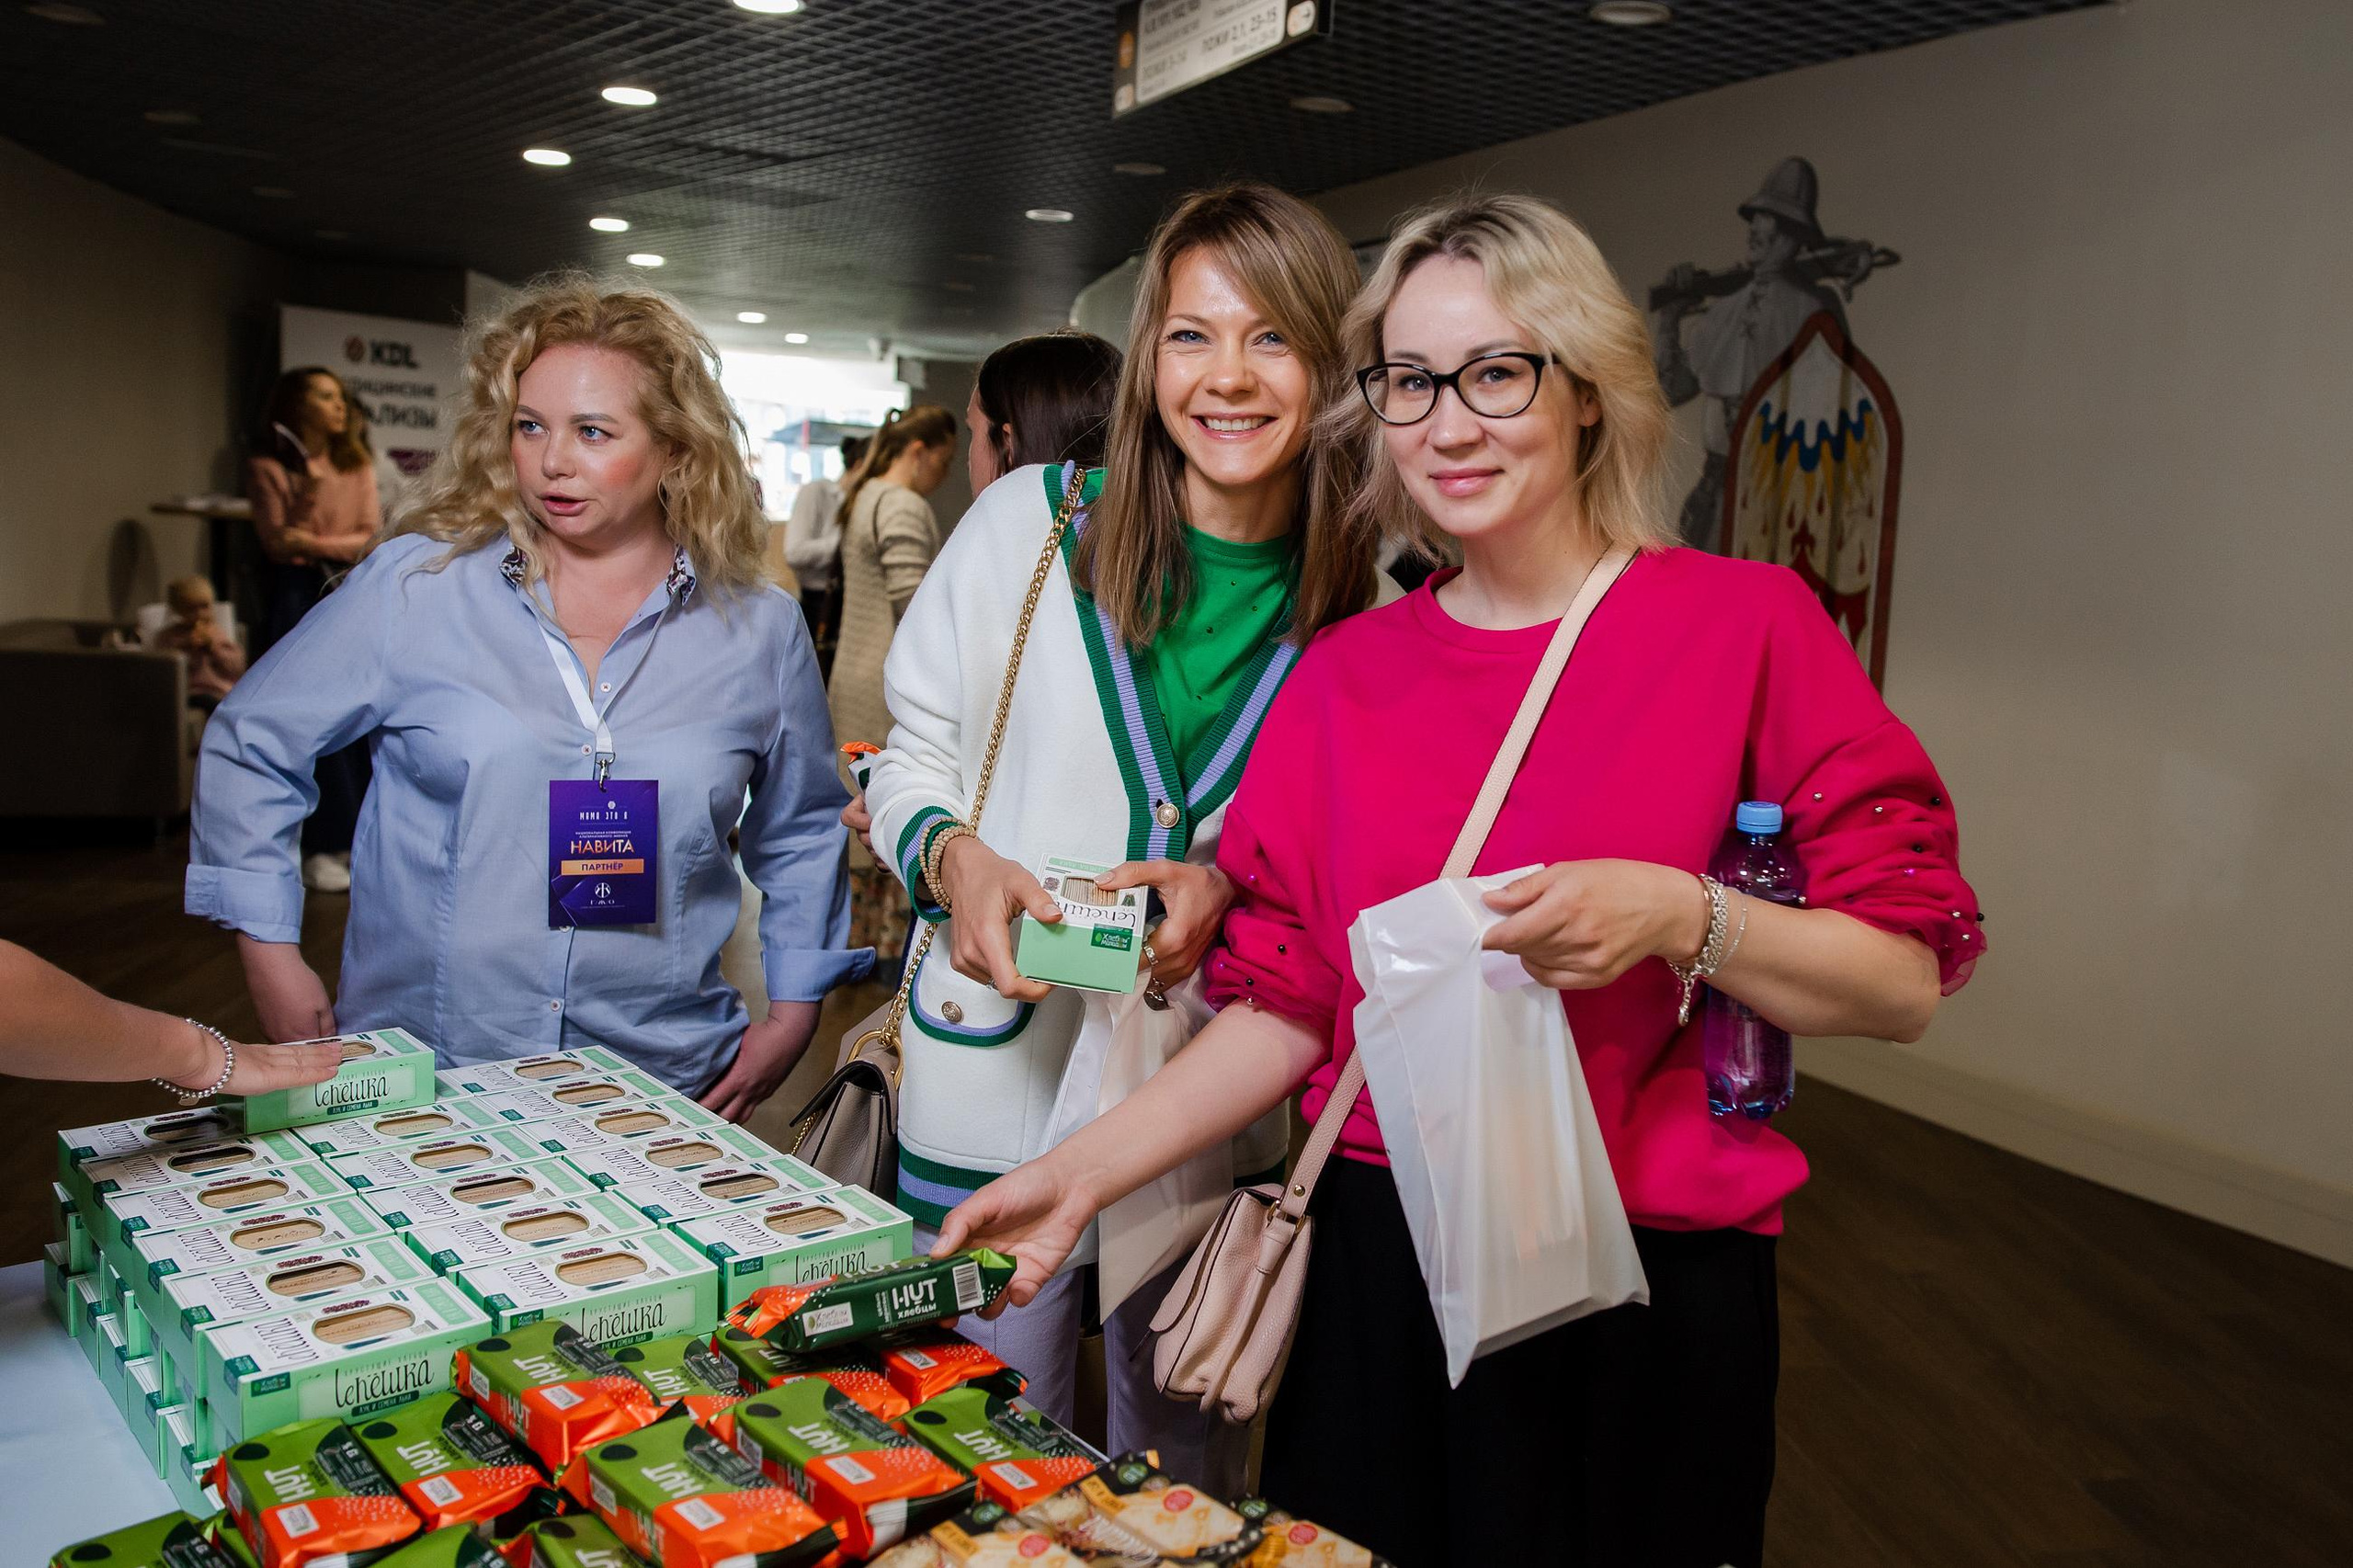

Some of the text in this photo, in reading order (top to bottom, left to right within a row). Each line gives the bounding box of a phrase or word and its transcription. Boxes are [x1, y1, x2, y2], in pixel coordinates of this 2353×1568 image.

[571, 839, 635, 854] НАВИТА
[581, 862, 623, 871] ПАРТНЁР
[892, 1278, 938, 1310] НУТ
[580, 1302, 668, 1343] Лепёшка
[897, 1302, 937, 1320] хлебцы
[334, 1358, 435, 1408] Лепёшка
[512, 1355, 568, 1385] НУТ
[643, 1368, 689, 1396] НУТ
[788, 1422, 850, 1454] НУТ
[953, 1428, 1012, 1461] НУТ
[396, 1440, 450, 1477] НУТ
[264, 1465, 316, 1503] НУТ
[641, 1461, 705, 1499] НУТ
